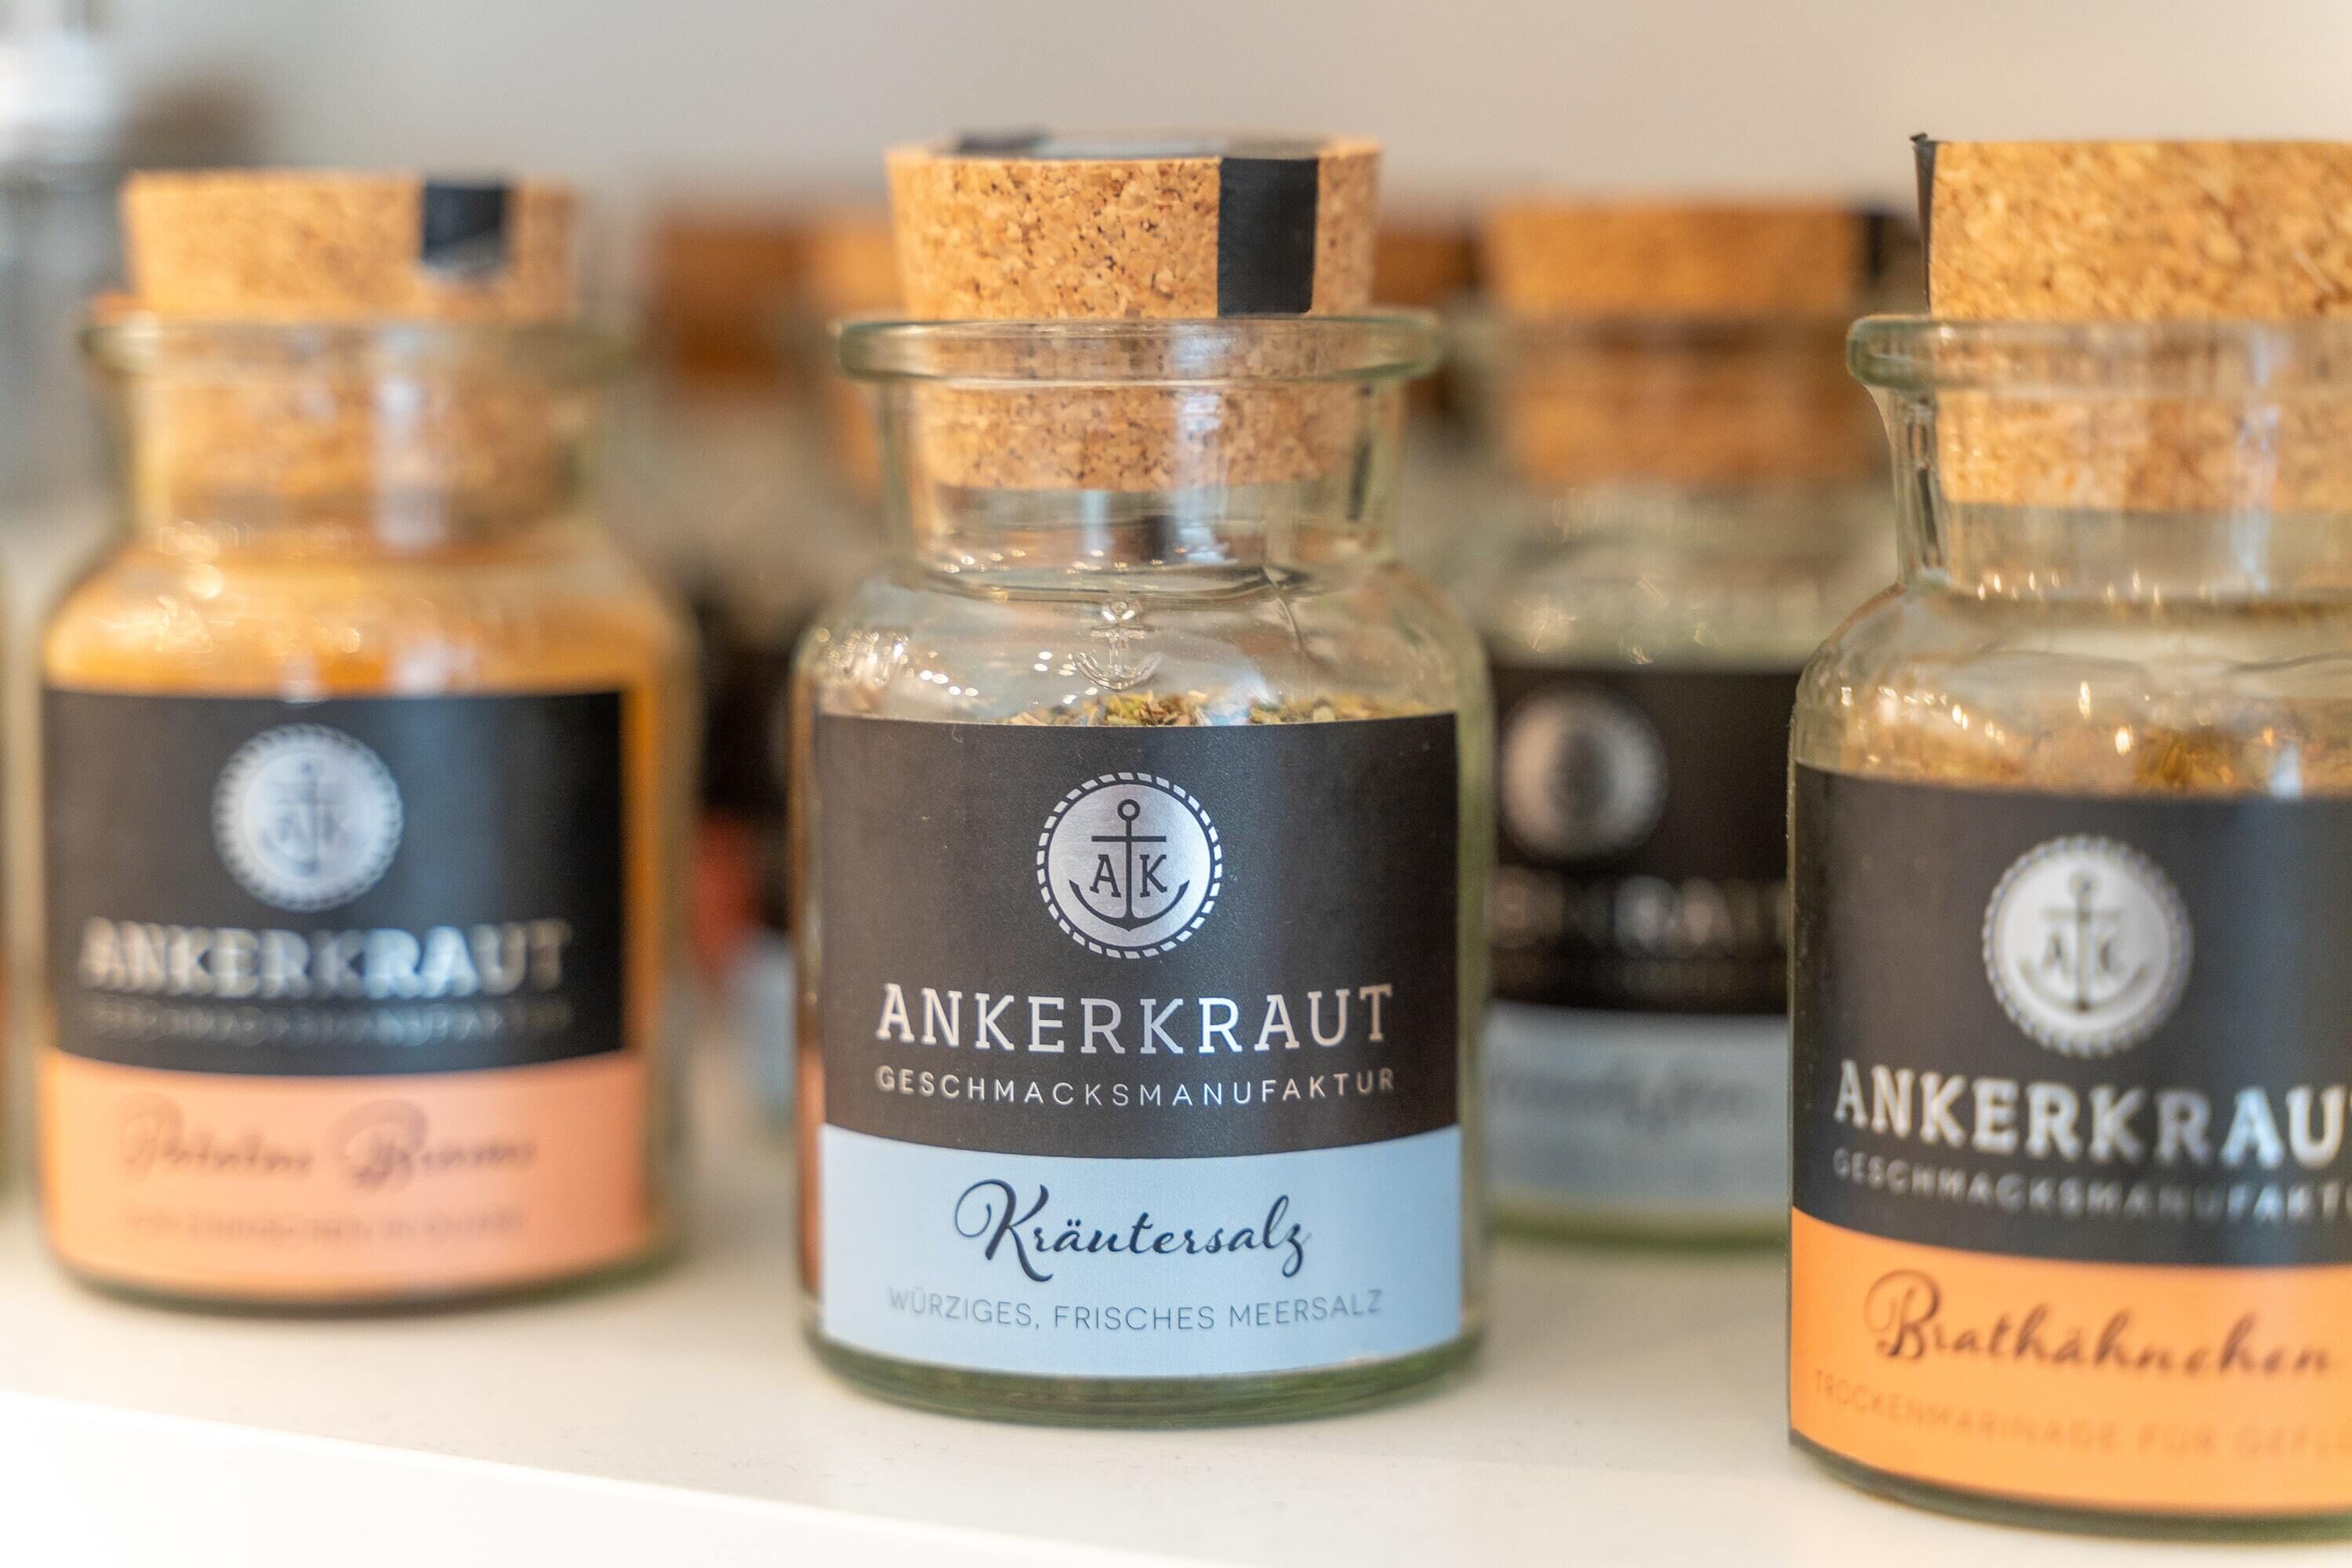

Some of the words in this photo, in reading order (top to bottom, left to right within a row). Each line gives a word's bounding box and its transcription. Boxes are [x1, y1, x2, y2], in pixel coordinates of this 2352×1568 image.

[79, 916, 572, 1000] ANKERKRAUT
[875, 982, 1393, 1055] ANKERKRAUT
[875, 1065, 1395, 1107] GESCHMACKSMANUFAKTUR
[1833, 1058, 2352, 1170] ANKERKRAU
[1832, 1147, 2352, 1224] GESCHMACKSMANUFAKT
[954, 1178, 1312, 1282] Kräutersalz
[887, 1286, 1040, 1330] WÜRZIGES,
[1054, 1305, 1214, 1331] FRISCHES
[1229, 1288, 1384, 1328] MEERSALZ
